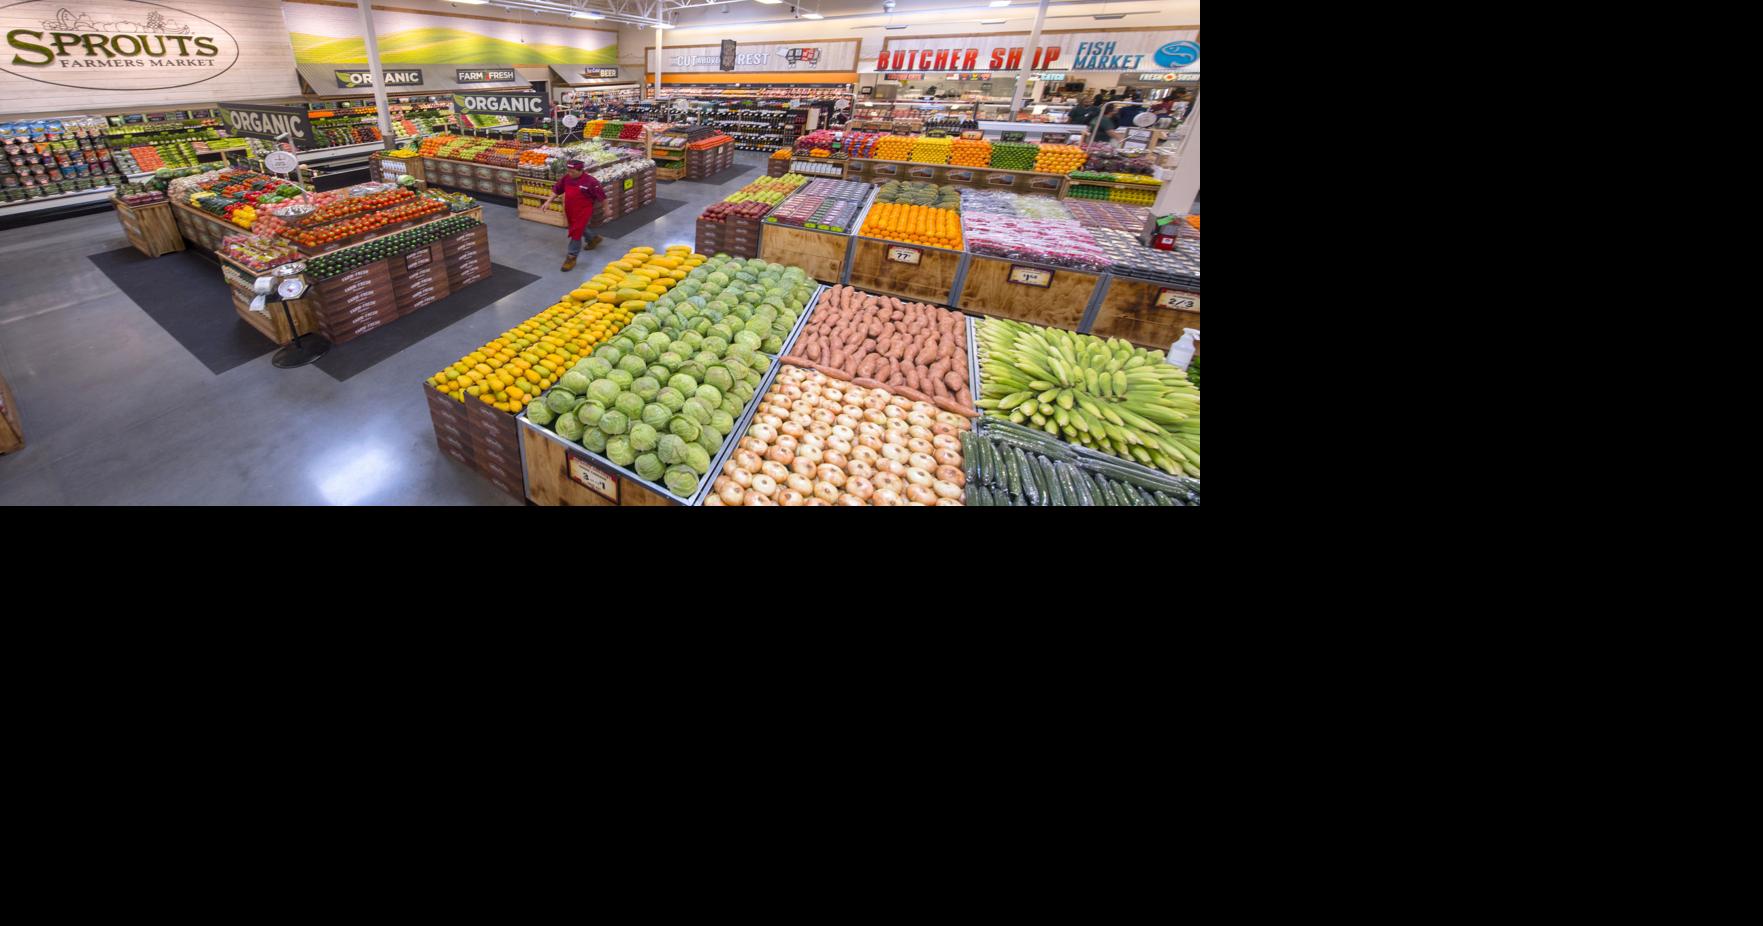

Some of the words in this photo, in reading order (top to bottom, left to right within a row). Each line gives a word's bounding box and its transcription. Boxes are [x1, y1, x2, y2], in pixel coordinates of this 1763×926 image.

[7, 29, 219, 68] SPROUTS
[1077, 40, 1117, 55] FISH
[61, 59, 144, 68] FARMERS
[150, 59, 215, 67] MARKET
[677, 55, 697, 66] CUT
[738, 53, 770, 65] REST
[877, 48, 978, 71] BUTCHER
[1073, 55, 1146, 70] MARKET
[350, 72, 419, 84] ORANIC
[459, 72, 483, 81] FARM
[489, 71, 513, 79] FRESH
[600, 69, 616, 77] BEER
[465, 96, 543, 112] ORGANIC
[230, 110, 305, 138] ORGANIC
